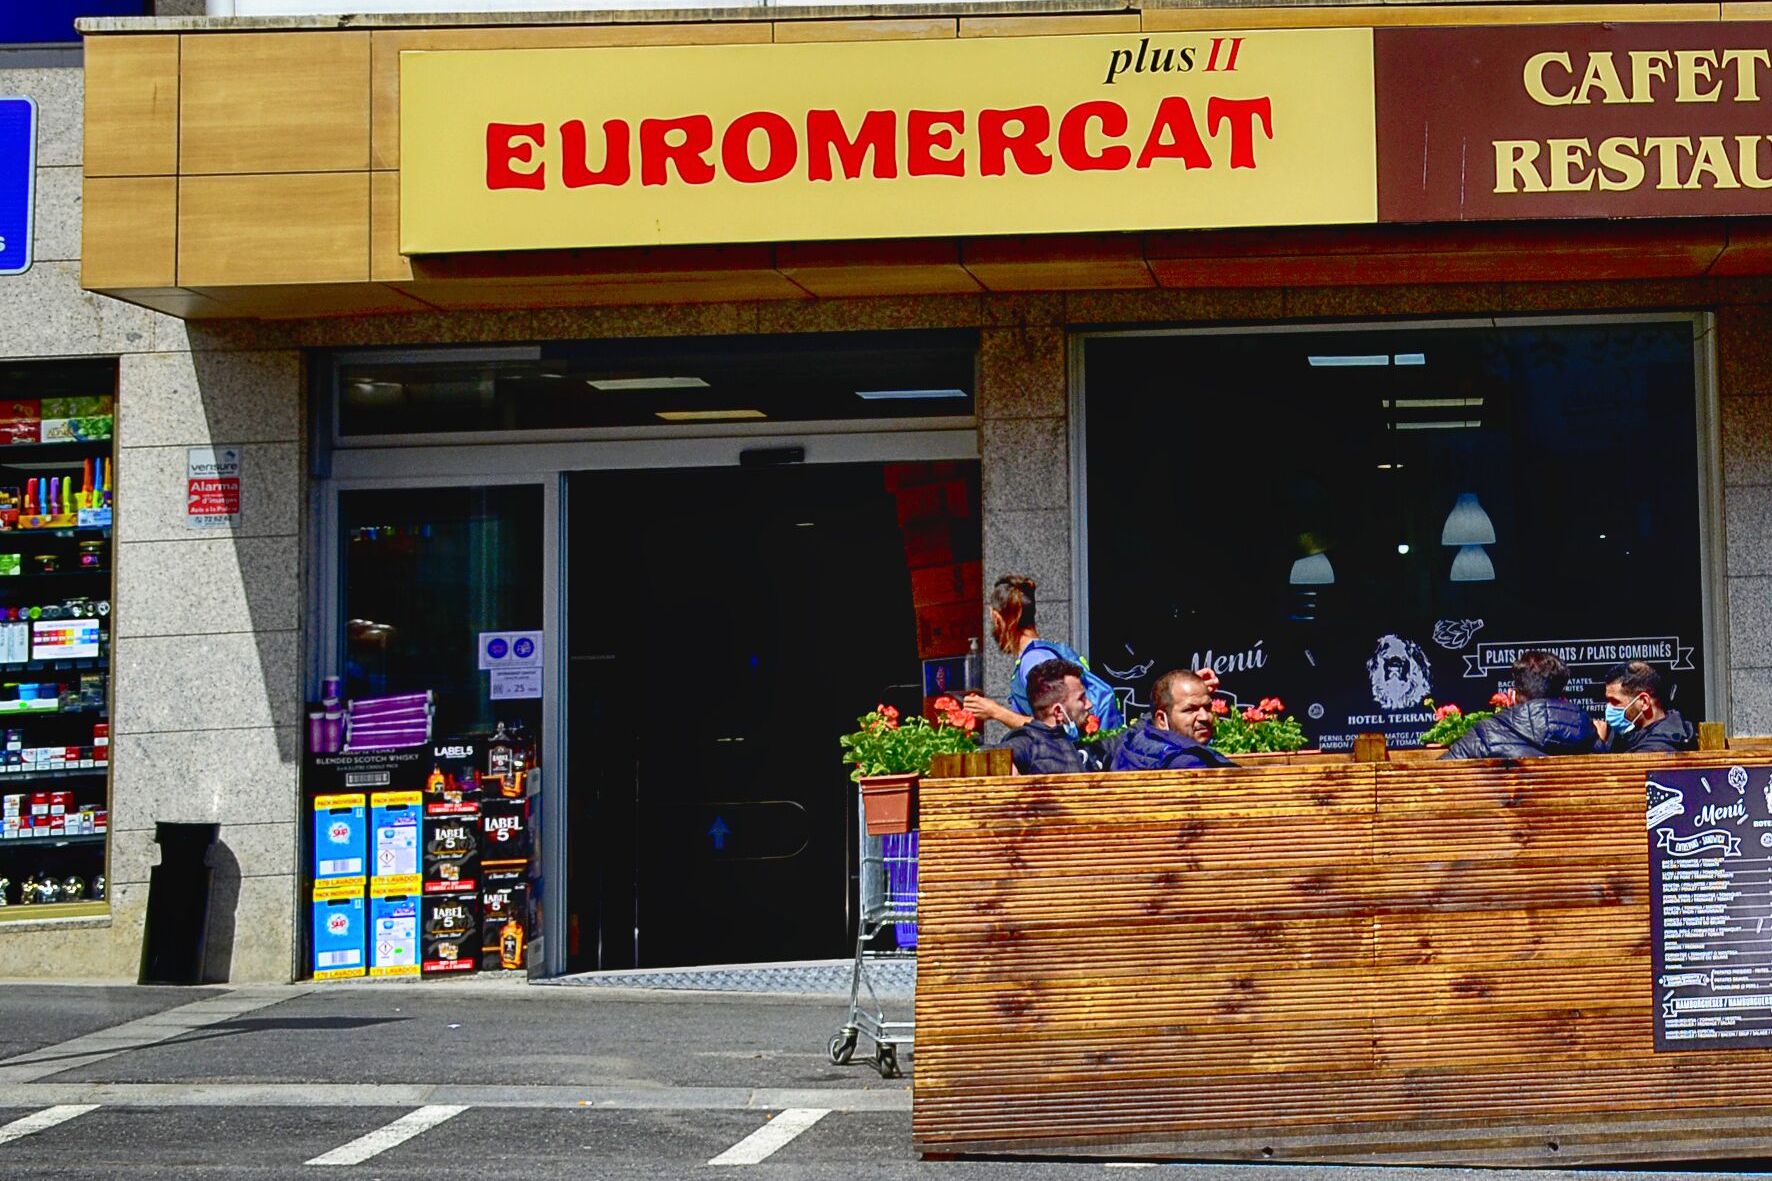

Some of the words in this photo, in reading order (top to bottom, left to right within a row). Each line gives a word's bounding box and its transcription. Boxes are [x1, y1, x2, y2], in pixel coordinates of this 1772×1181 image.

[1103, 38, 1197, 85] plus
[1202, 36, 1247, 73] II
[485, 95, 1274, 191] EUROMERCAT
[191, 463, 238, 472] verisure
[191, 481, 239, 492] Alarma
[1190, 639, 1268, 675] Menú
[1486, 650, 1516, 664] PLATS
[1587, 647, 1617, 660] PLATS
[1619, 641, 1672, 659] COMBINÉS
[514, 684, 525, 693] 25
[1348, 714, 1386, 725] HOTEL
[1319, 734, 1345, 742] PERNIL
[1319, 741, 1349, 751] JAMBON
[316, 755, 353, 765] BLENDED
[354, 754, 387, 764] SCOTCH
[389, 753, 419, 762] WHISKY
[1693, 798, 1747, 827] Menú
[484, 815, 524, 832] LABEL
[435, 827, 468, 840] LABEL
[496, 828, 510, 842] 5
[445, 837, 456, 849] 5
[483, 893, 511, 905] LABEL
[492, 901, 501, 911] 5
[433, 906, 466, 920] LABEL
[443, 916, 454, 928] 5
